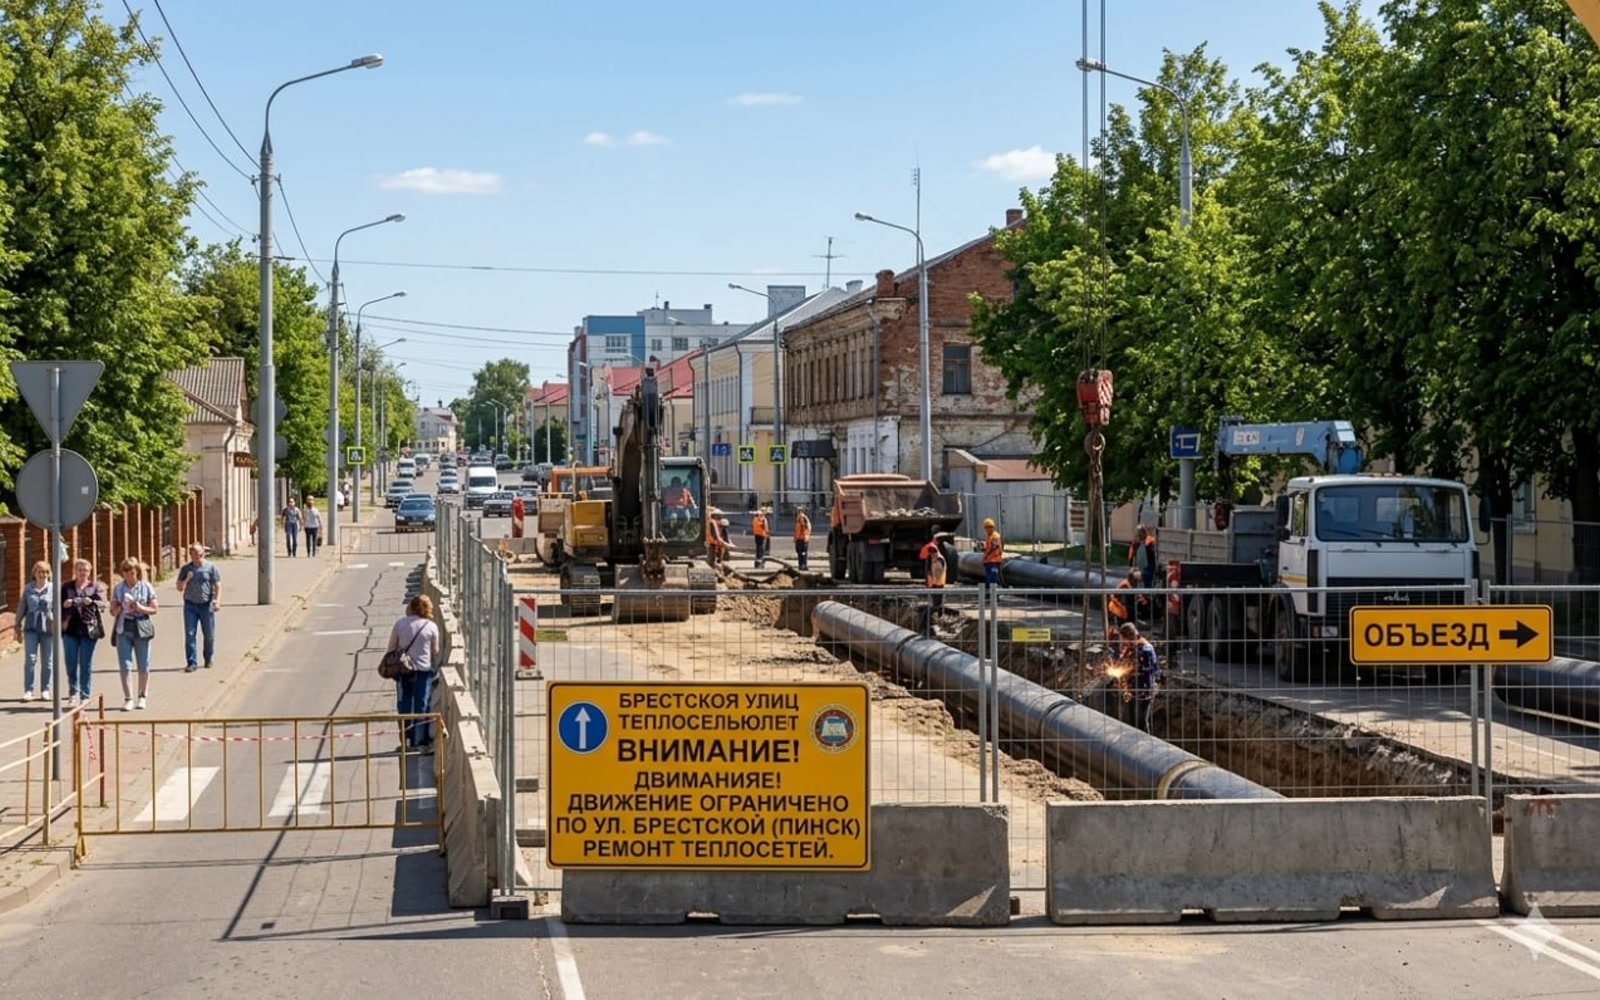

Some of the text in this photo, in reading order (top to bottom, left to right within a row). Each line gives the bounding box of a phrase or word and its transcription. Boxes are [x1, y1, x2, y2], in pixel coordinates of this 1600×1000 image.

[1364, 622, 1490, 651] ОБЪЕЗД
[619, 692, 800, 712] БРЕСТСКОЯ УЛИЦ
[618, 713, 800, 731] ТЕПЛОСЕЛЬЮЛЕТ
[617, 738, 800, 763] ВНИМАНИЕ!
[634, 771, 781, 791] ДВИМАНИЯЕ!
[568, 794, 849, 814] ДВИЖЕНИЕ ОГРАНИЧЕНО
[555, 814, 861, 840] ПО УЛ. БРЕСТСКОЙ (ПИНСК)
[583, 837, 834, 859] РЕМОНТ ТЕПЛОСЕТЕЙ.
